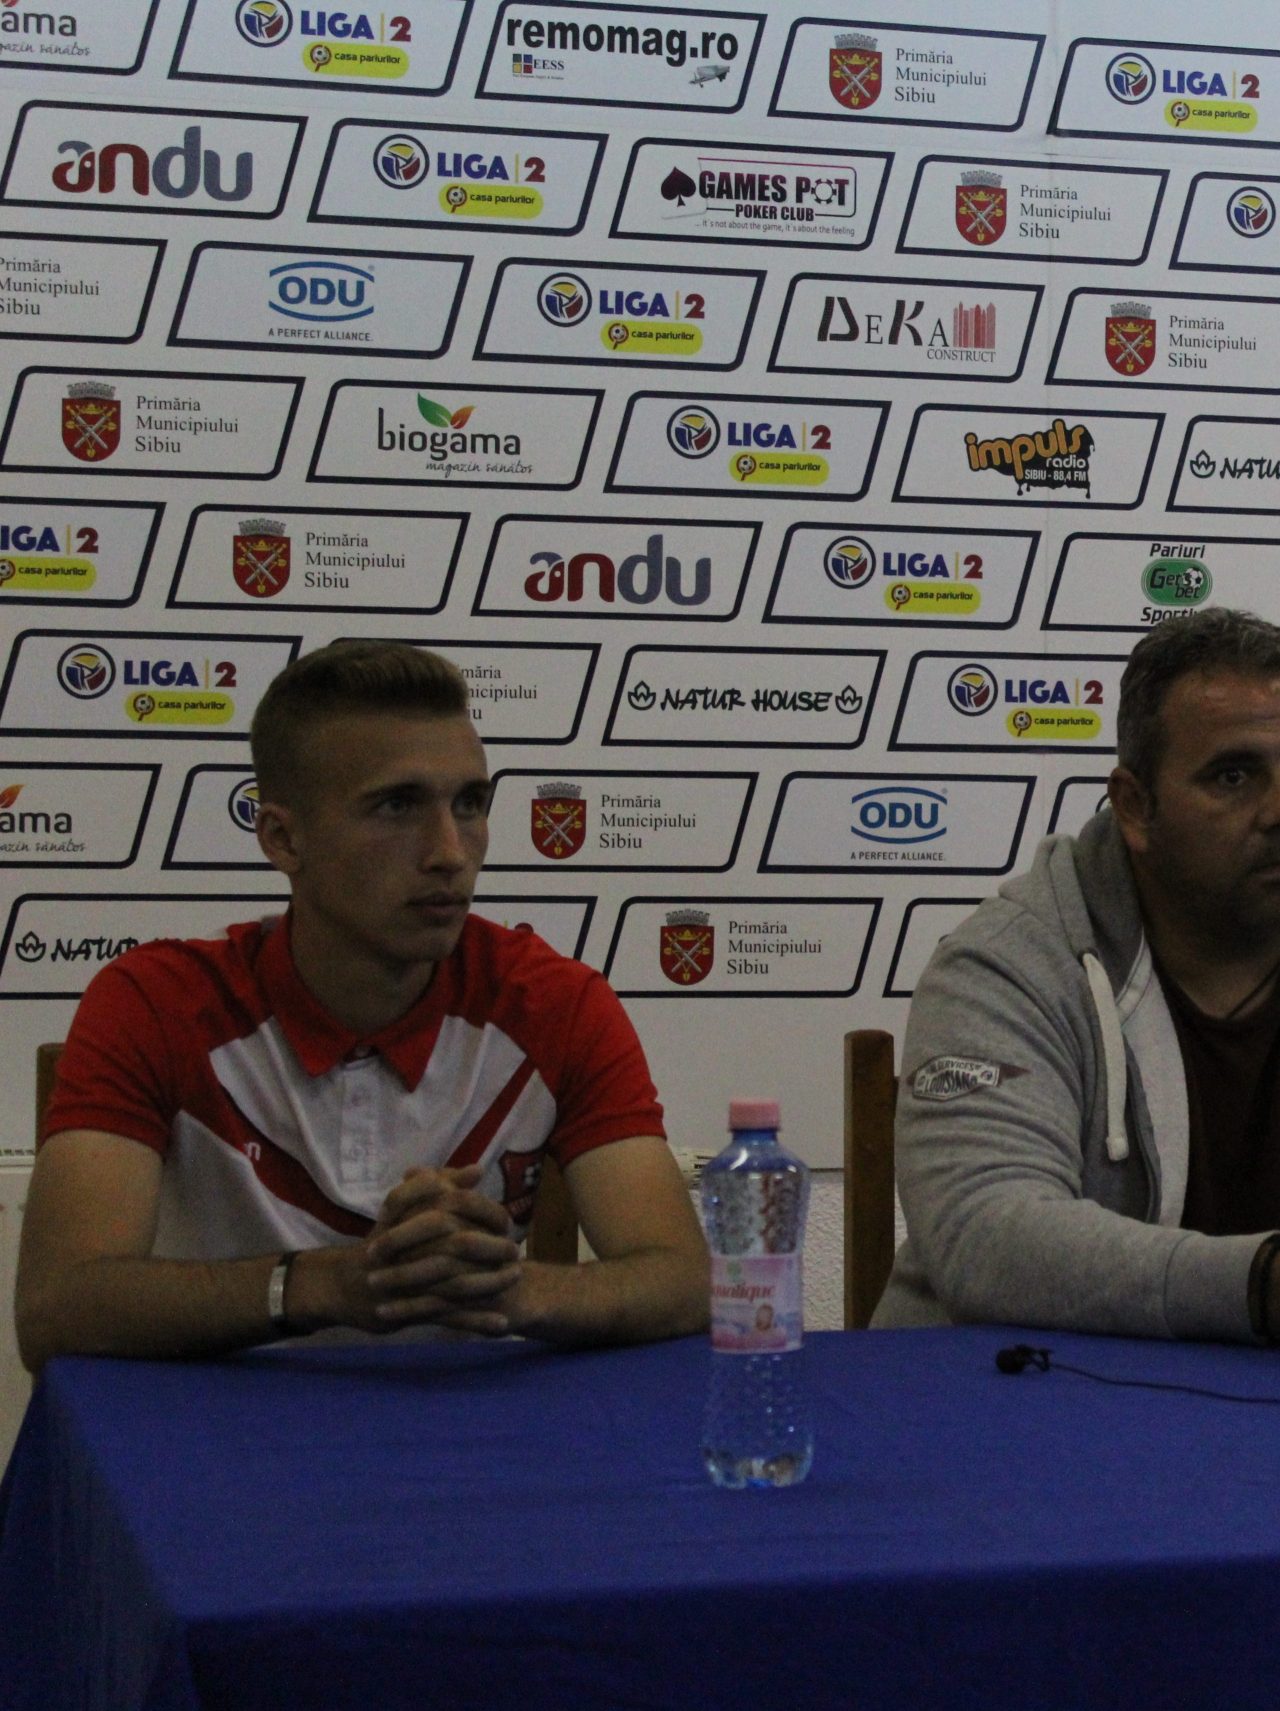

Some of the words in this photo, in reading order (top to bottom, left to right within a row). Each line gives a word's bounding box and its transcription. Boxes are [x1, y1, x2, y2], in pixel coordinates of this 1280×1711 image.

[301, 10, 374, 39] LIGA
[390, 16, 411, 42] 2
[507, 19, 738, 66] remomag.ro
[334, 53, 357, 61] casa
[534, 59, 564, 69] EESS
[896, 66, 986, 87] Municipiului
[895, 87, 935, 103] Sibiu
[52, 126, 252, 201] andu
[437, 152, 509, 180] LIGA
[525, 157, 545, 182] 2
[699, 171, 787, 203] GAMES
[470, 194, 492, 202] casa
[735, 204, 777, 219] POKER
[781, 207, 814, 221] CLUB
[1021, 203, 1110, 225] Municipiului
[1019, 223, 1059, 239] Sibiu
[278, 276, 366, 308] ODU
[268, 328, 274, 336] A
[277, 328, 320, 338] PERFECT
[1169, 333, 1256, 352] Municipiului
[927, 349, 995, 362] CONSTRUCT
[1168, 353, 1207, 368] Sibiu
[137, 415, 238, 435] Municipiului
[378, 407, 521, 460] biogama
[135, 436, 180, 453] Sibiu
[728, 422, 796, 448] LIGA
[811, 425, 831, 449] 2
[965, 419, 1087, 482] impuls
[1046, 455, 1087, 469] radio
[1024, 468, 1047, 480] SIBIU
[1074, 470, 1087, 481] FM
[0, 526, 60, 552] IGA
[77, 527, 98, 553] 2
[1150, 543, 1205, 558] Pariuri
[306, 551, 405, 571] Municipiului
[524, 535, 711, 605] andu
[305, 572, 349, 588] Sibiu
[124, 660, 199, 686] LIGA
[215, 662, 236, 687] 2
[660, 687, 745, 710] NATUR
[751, 689, 832, 712] HOUSE
[1005, 680, 1070, 704] LIGA
[1084, 680, 1103, 704] 2
[601, 813, 695, 831] Municipiului
[860, 802, 938, 829] ODU
[600, 833, 642, 848] Sibiu
[859, 851, 898, 860] PERFECT
